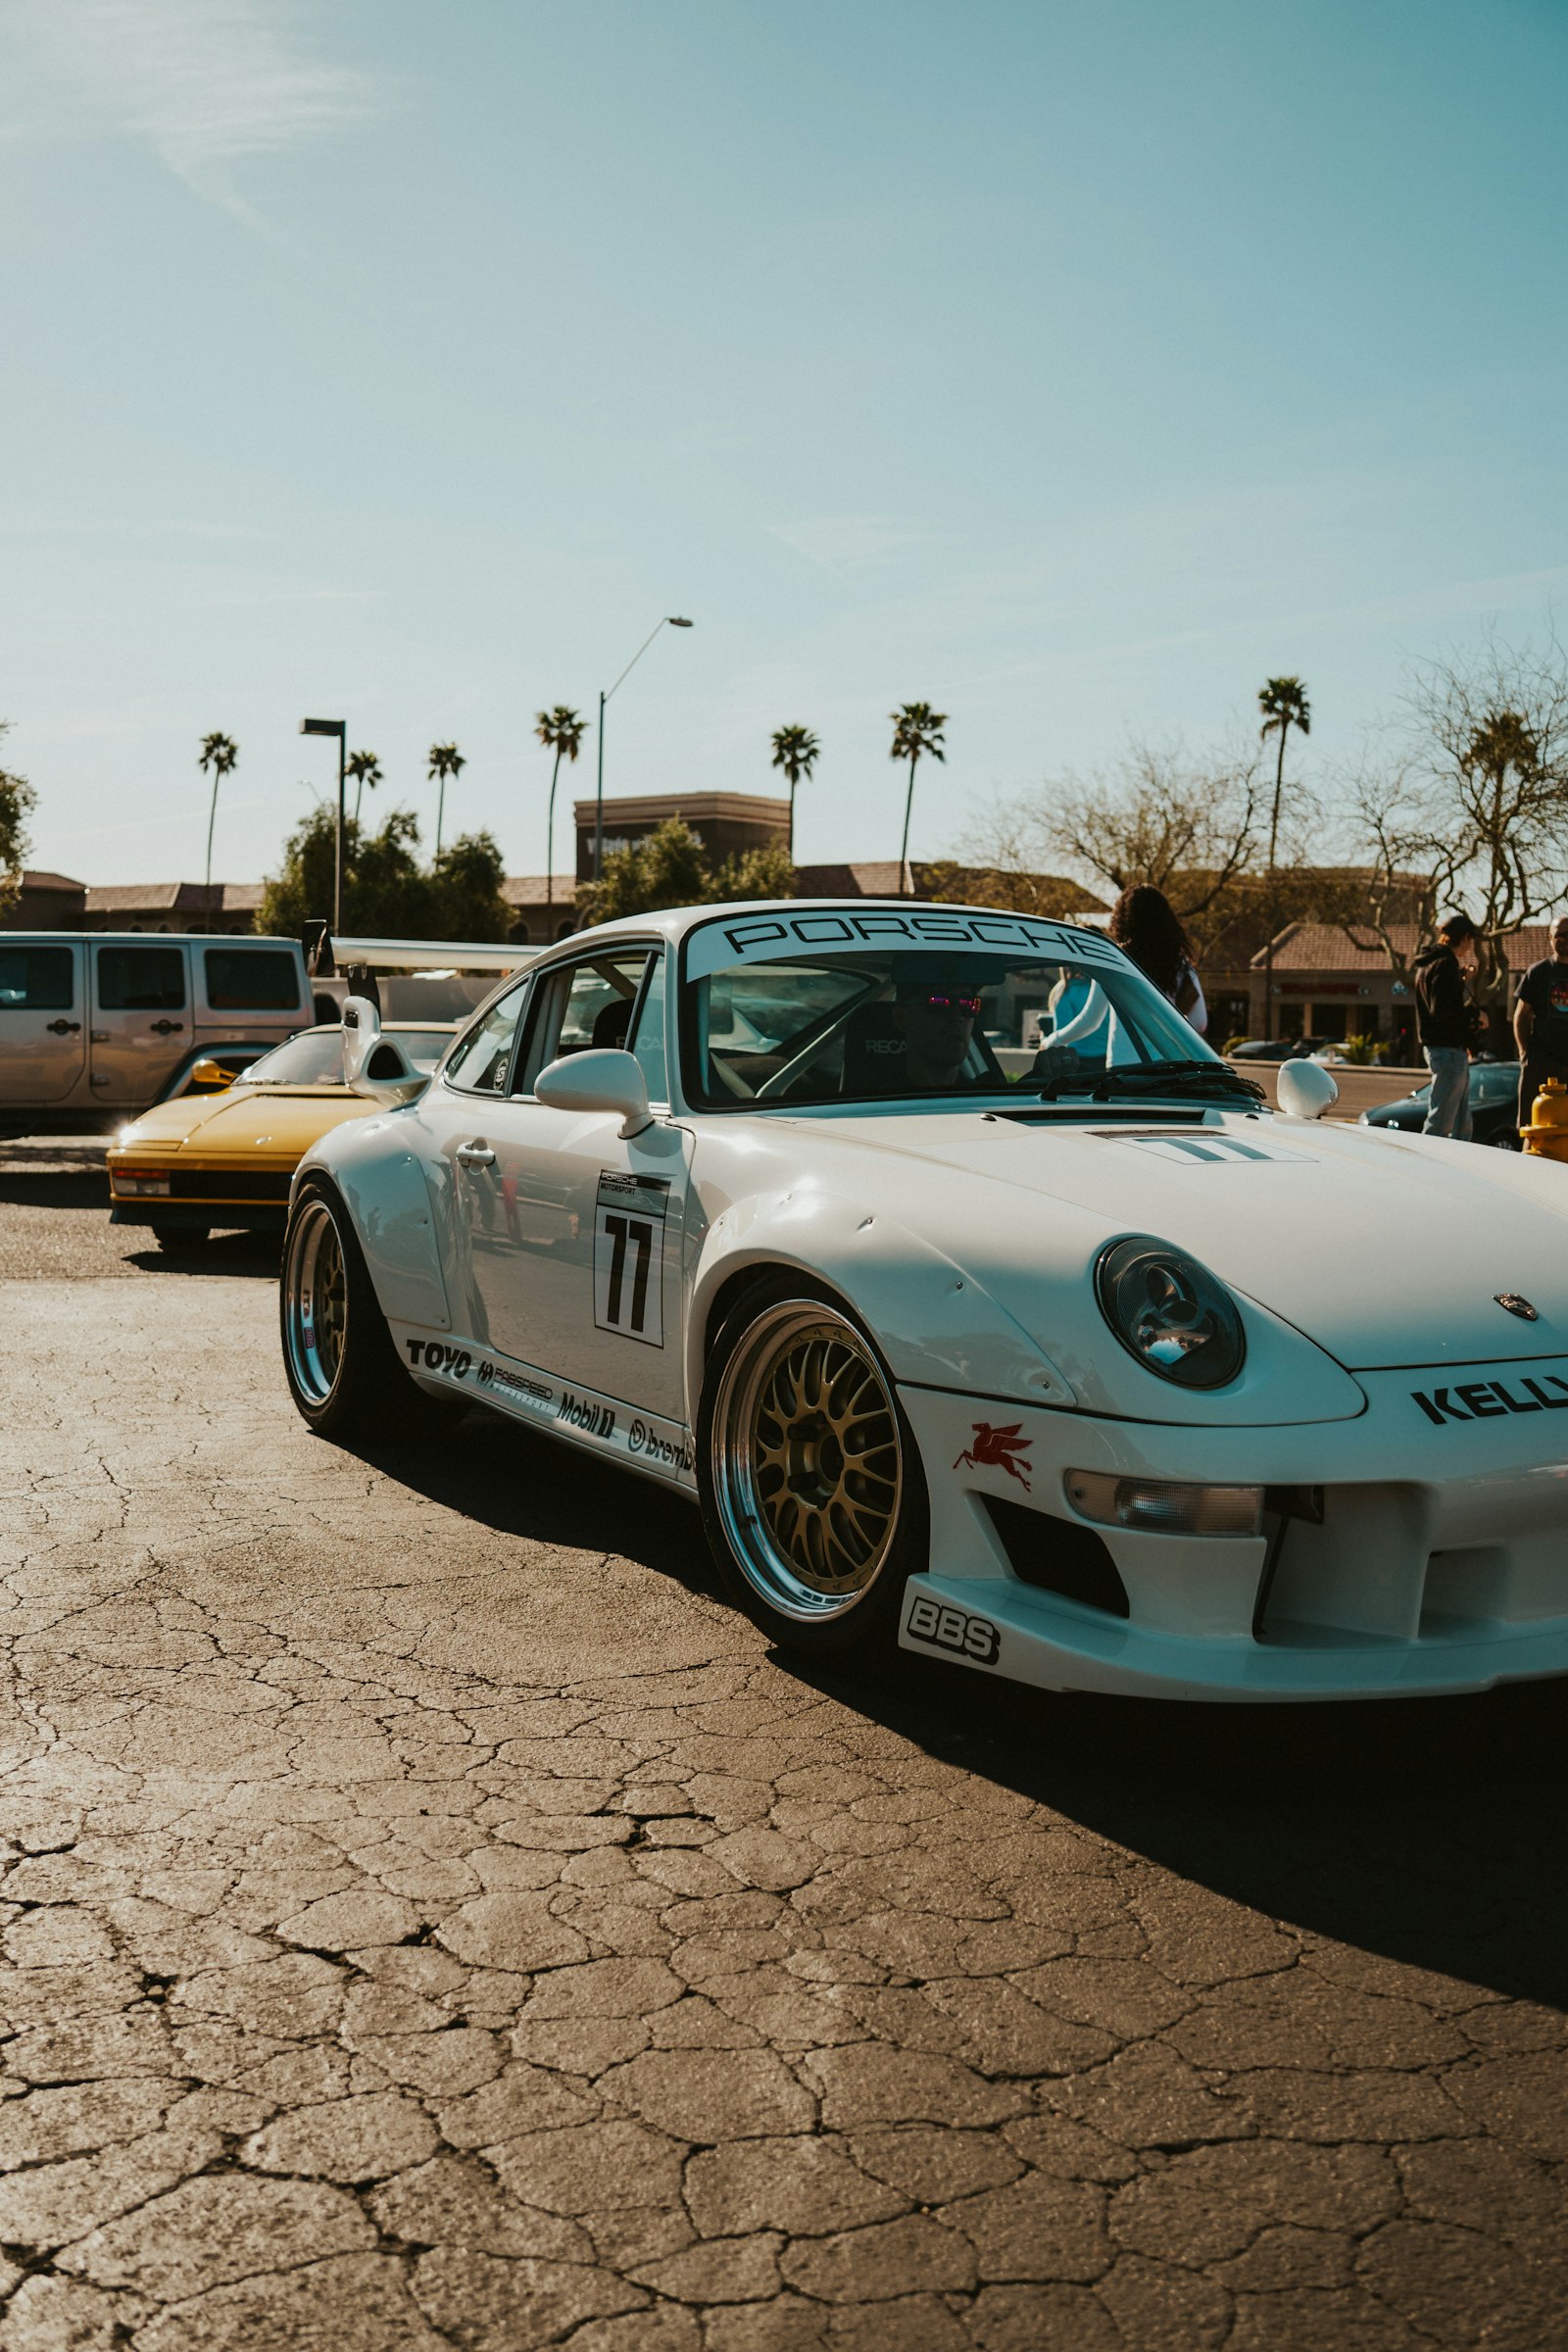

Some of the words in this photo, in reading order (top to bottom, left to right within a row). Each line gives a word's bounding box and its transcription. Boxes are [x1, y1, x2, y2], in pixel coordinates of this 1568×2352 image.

[722, 917, 1126, 967] PORSCHE
[600, 1181, 636, 1196] MOTORSPORT
[601, 1172, 638, 1186] PORSCHE
[407, 1339, 472, 1379] TOYO
[490, 1382, 551, 1412] MOTORSPORT
[494, 1367, 554, 1400] FABSPEED
[557, 1392, 601, 1433] Mobil
[600, 1408, 613, 1437] 1
[906, 1595, 1002, 1666] BBS
